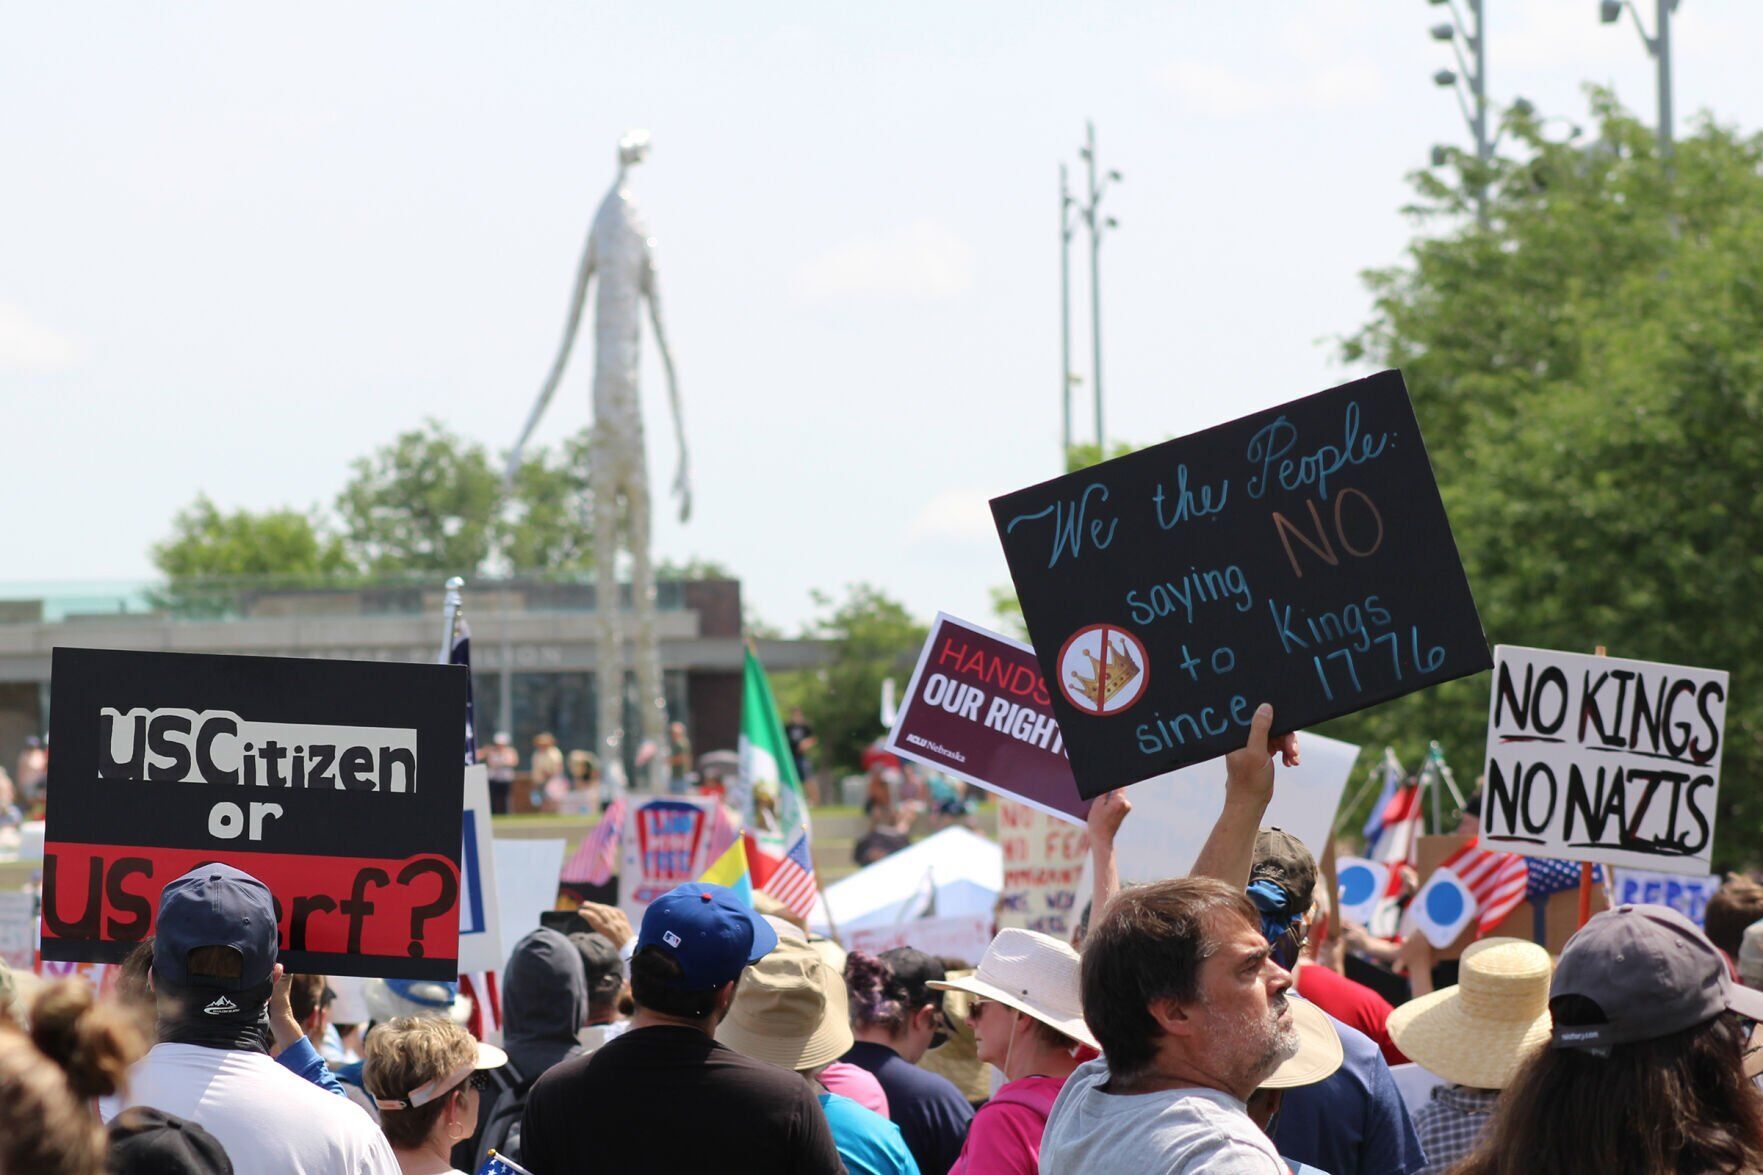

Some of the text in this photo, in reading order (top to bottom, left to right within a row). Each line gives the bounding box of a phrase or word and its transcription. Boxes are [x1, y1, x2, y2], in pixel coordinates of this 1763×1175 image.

[1007, 401, 1399, 568] We the People:
[1126, 487, 1383, 624] saying NO
[938, 638, 1051, 705] HANDS
[1136, 625, 1446, 754] since 1776
[1181, 645, 1236, 681] to
[1495, 660, 1725, 763] NO KINGS
[922, 673, 1069, 760] OUR RIGHT
[926, 741, 966, 763] Nebraska
[208, 801, 283, 841] or
[1485, 757, 1715, 856] NO NAZIS
[44, 853, 153, 941] US
[186, 858, 459, 958] rf?
